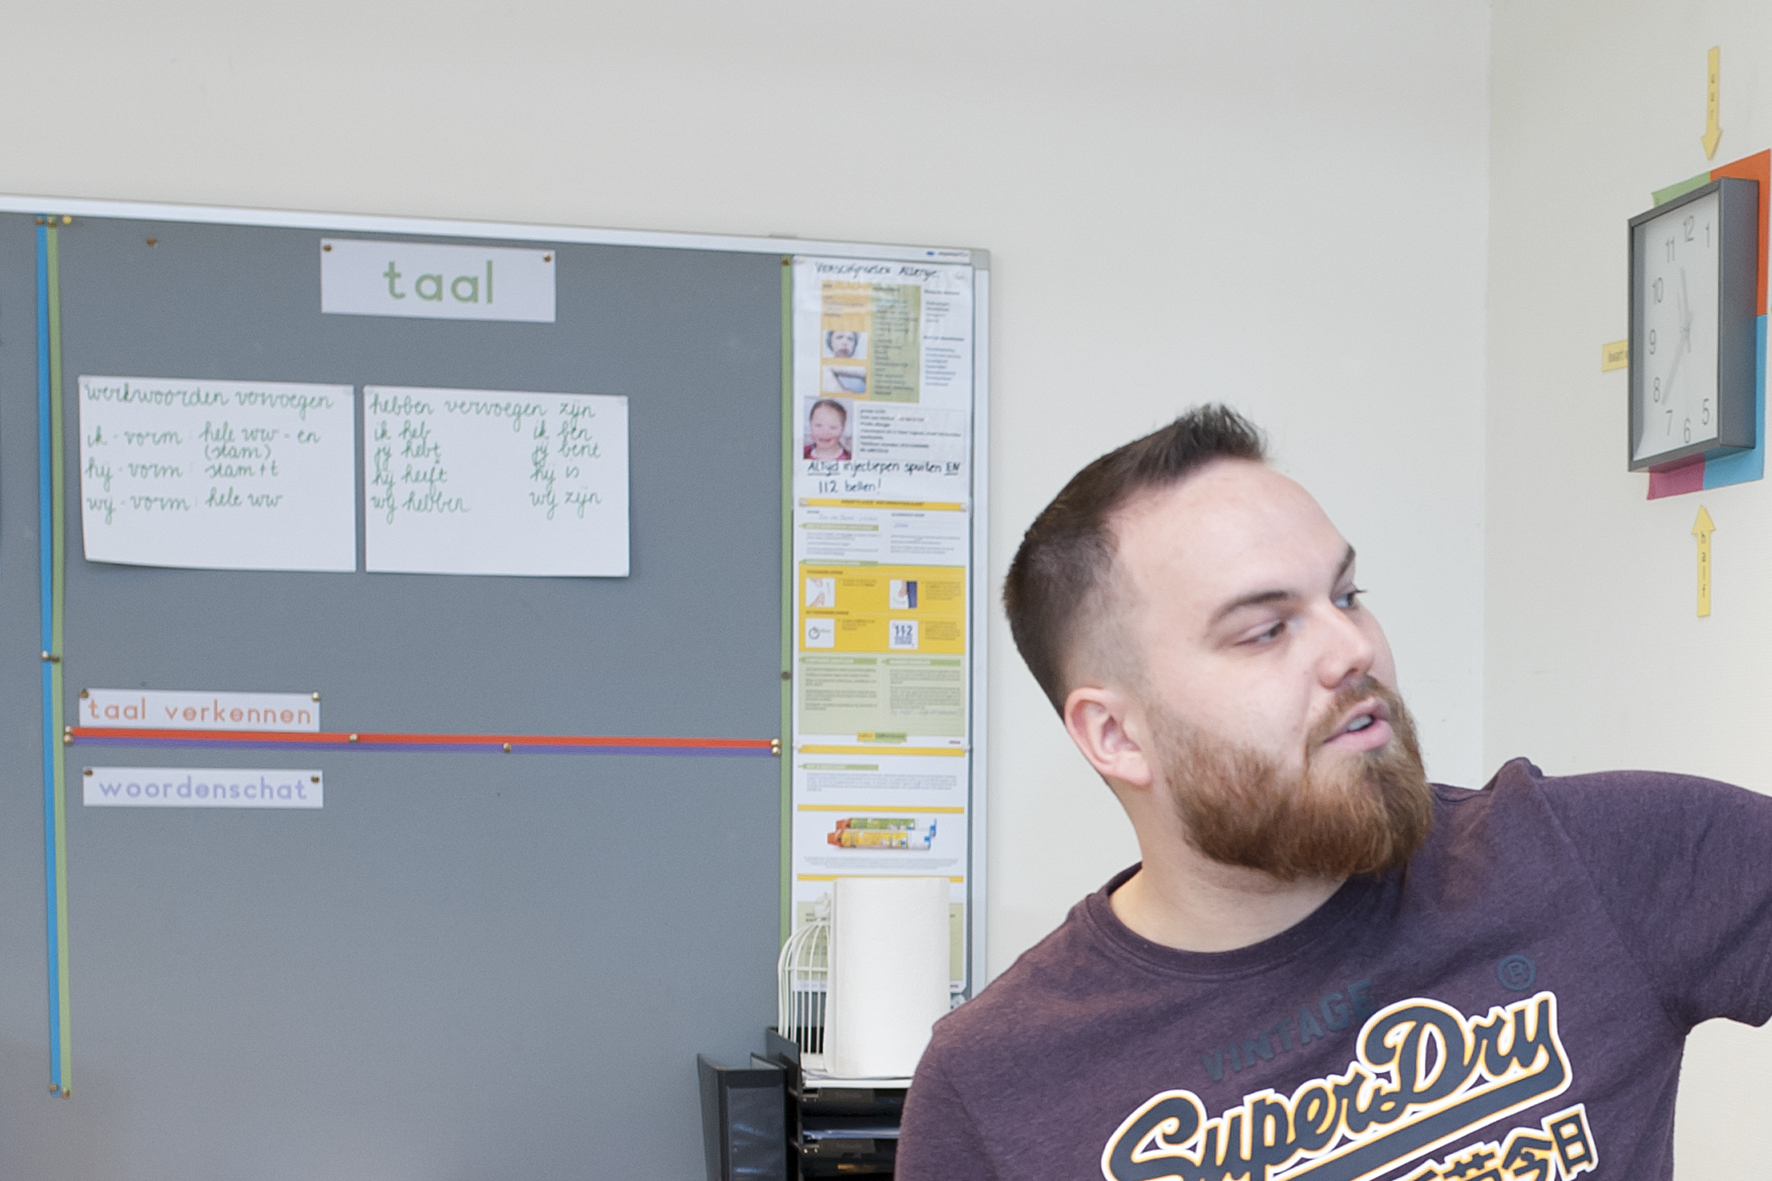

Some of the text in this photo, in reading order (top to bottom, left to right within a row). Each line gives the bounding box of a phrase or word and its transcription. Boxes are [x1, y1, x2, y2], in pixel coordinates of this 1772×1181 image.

[1682, 214, 1696, 244] 12
[1665, 235, 1676, 264] 11
[382, 259, 495, 304] taal
[1651, 276, 1664, 304] 10
[1650, 328, 1657, 355] 9
[84, 383, 230, 408] werkwoorden
[1653, 376, 1661, 404] 8
[369, 392, 435, 417] hebben
[444, 399, 548, 433] vervoegen
[1665, 409, 1673, 436] 7
[1701, 398, 1710, 426] 5
[124, 429, 183, 447] vorm
[297, 429, 322, 445] en
[399, 420, 432, 442] heb
[557, 420, 593, 442] ben
[1683, 417, 1691, 444] 6
[128, 461, 184, 479] vorm
[818, 479, 839, 494] 112
[130, 496, 191, 513] vorm
[88, 696, 313, 726] taal verkennen
[99, 774, 308, 802] woordenschat
[1201, 978, 1379, 1083] VINTAGE
